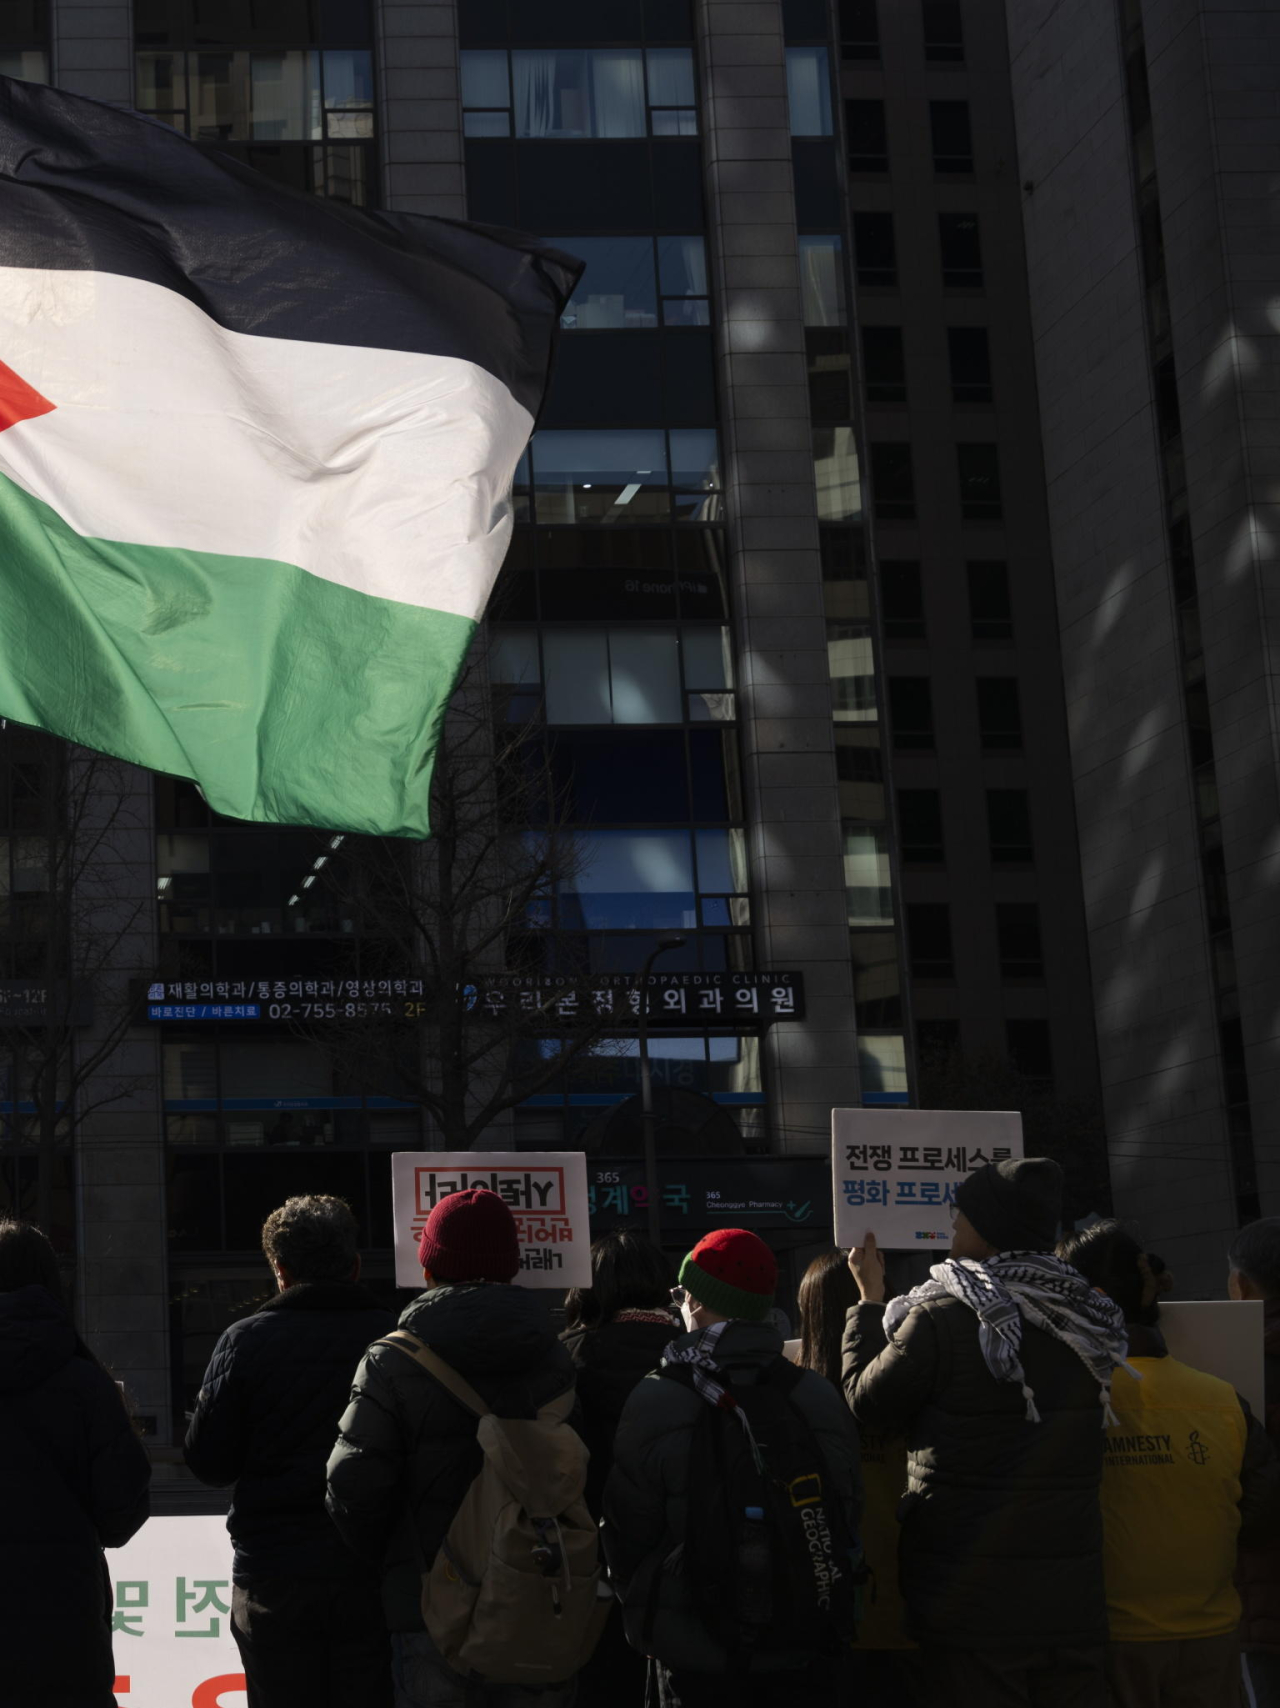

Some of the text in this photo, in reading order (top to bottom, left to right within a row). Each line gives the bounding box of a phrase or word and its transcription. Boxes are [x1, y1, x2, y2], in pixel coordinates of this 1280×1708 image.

[601, 975, 722, 986] ORTOPAEDIC
[733, 974, 792, 985] CLINIC
[151, 1005, 197, 1018] 바로진단
[404, 1001, 426, 1018] 2F
[846, 1144, 892, 1171] 전쟁
[596, 1172, 620, 1183] 365
[706, 1191, 721, 1200] 365
[843, 1179, 890, 1206] 평화
[749, 1200, 783, 1208] Pharmacy
[1104, 1434, 1171, 1453] AMNESTY
[1104, 1453, 1175, 1466] INTERNATIONAL
